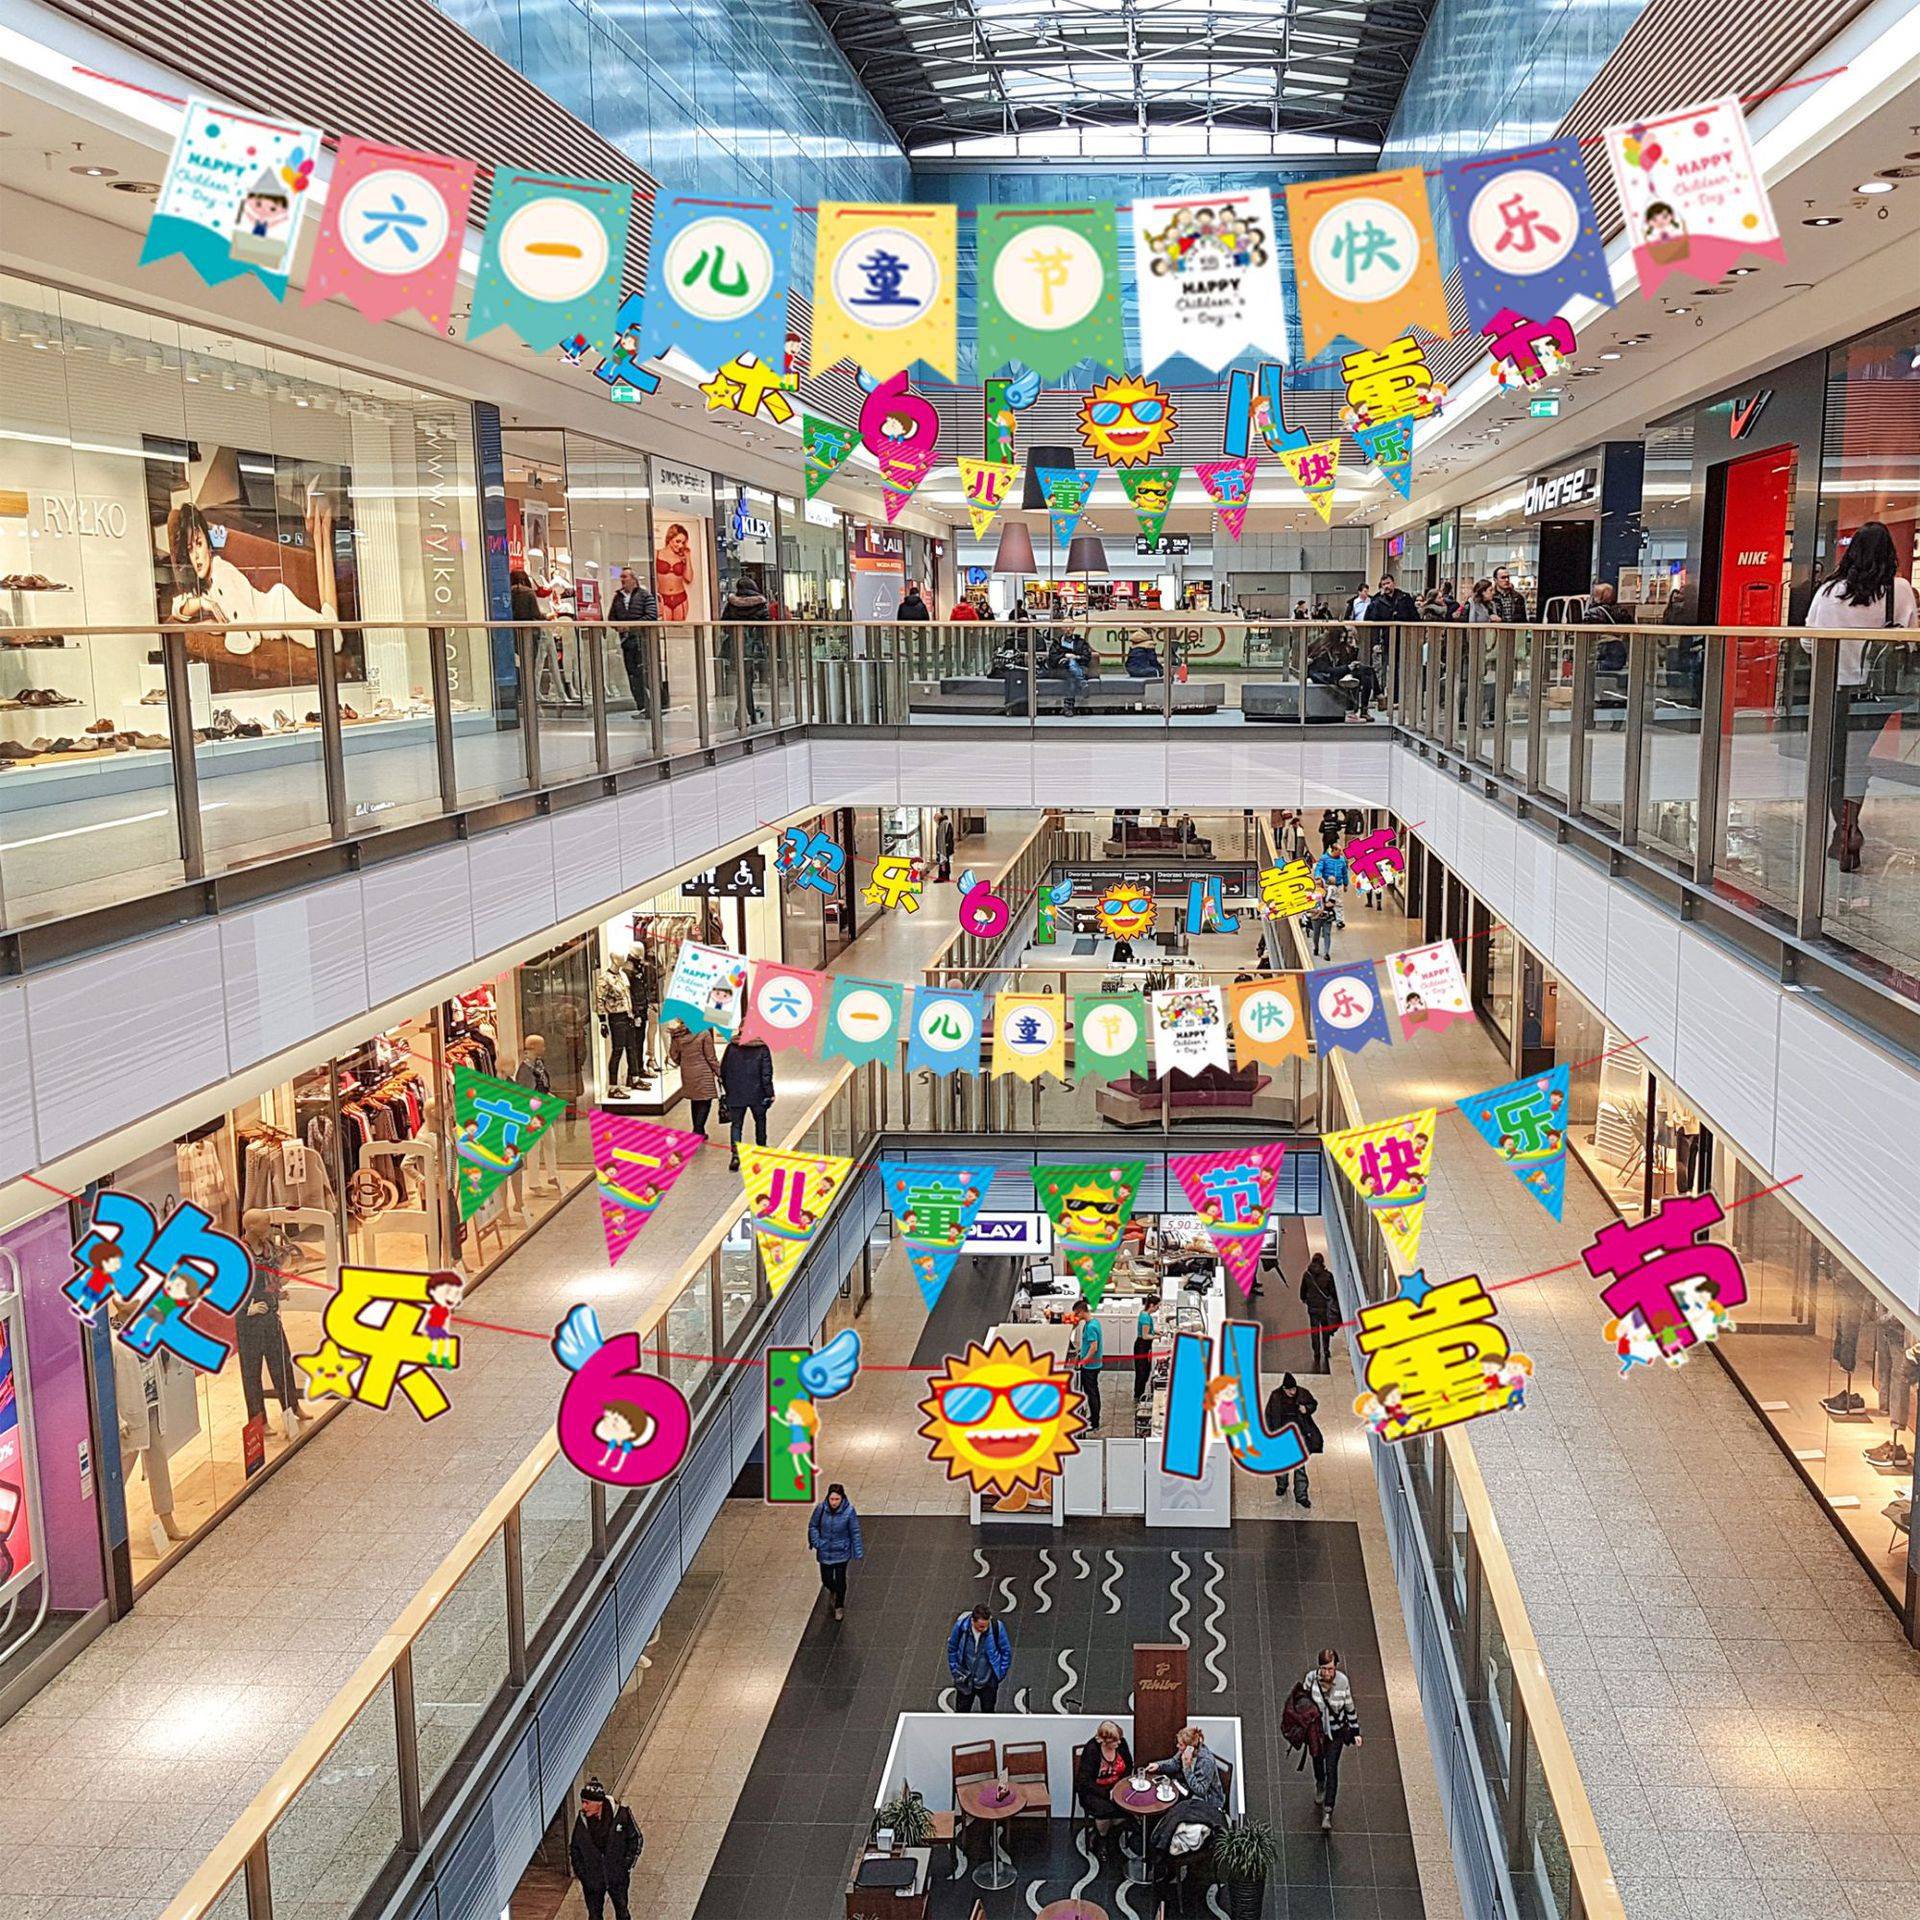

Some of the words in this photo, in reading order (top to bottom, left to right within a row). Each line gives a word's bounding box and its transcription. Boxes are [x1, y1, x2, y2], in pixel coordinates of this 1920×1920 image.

[188, 152, 244, 177] HAPPY
[1676, 151, 1733, 176] HAPPY
[362, 193, 427, 253] 六
[682, 244, 750, 298] 儿
[848, 247, 921, 307] 童
[1033, 244, 1075, 314] 节
[1330, 219, 1400, 284] 快
[1495, 193, 1560, 254] 乐
[1182, 278, 1240, 295] HAPPY
[974, 470, 996, 501] 儿
[1524, 468, 1585, 516] diverse
[42, 495, 127, 539] RYŁKO
[741, 514, 772, 537] KLEX
[1159, 538, 1167, 549] P
[1738, 552, 1767, 565] NIKE
[683, 967, 711, 980] HAPPY
[1421, 967, 1450, 980] HAPPY
[769, 988, 802, 1018] 六
[928, 1014, 961, 1040] 儿
[1011, 1016, 1046, 1044] 童
[1250, 1001, 1282, 1033] 快
[1330, 988, 1362, 1018] 乐
[472, 1098, 531, 1147] 六
[768, 1168, 807, 1226] 儿
[906, 1182, 964, 1241] 童
[1202, 1164, 1265, 1223] 节
[1358, 1136, 1420, 1197] 快
[1495, 1091, 1553, 1153] 乐
[322, 1265, 459, 1423] 乐
[557, 1332, 690, 1486] 6
[1161, 1320, 1309, 1480] 儿
[1356, 1274, 1511, 1443] 童
[1581, 1192, 1748, 1357] 节
[1139, 1680, 1183, 1690] Tchibo
